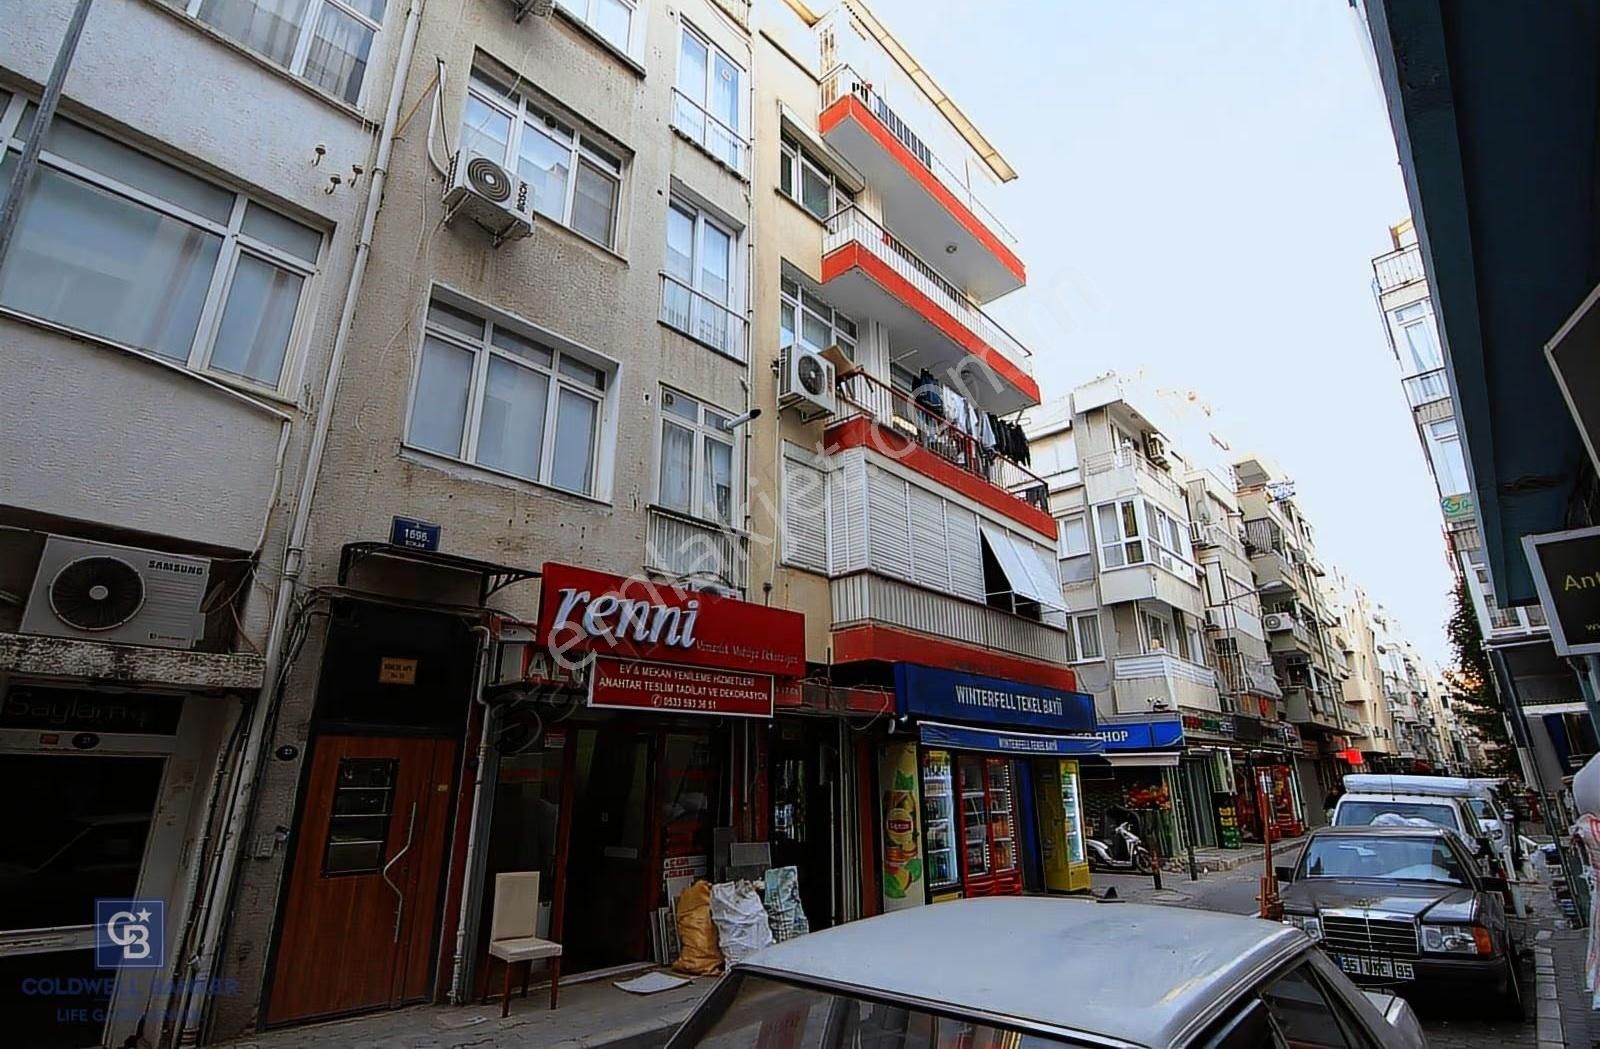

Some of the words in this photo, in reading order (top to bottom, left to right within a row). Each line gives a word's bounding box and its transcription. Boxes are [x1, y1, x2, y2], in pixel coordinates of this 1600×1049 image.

[148, 560, 203, 575] SAMSUNG
[552, 586, 698, 650] renni
[599, 677, 642, 690] ANAHTAR
[955, 685, 1016, 711] WINTERFELL
[1016, 695, 1042, 713] TEKEL
